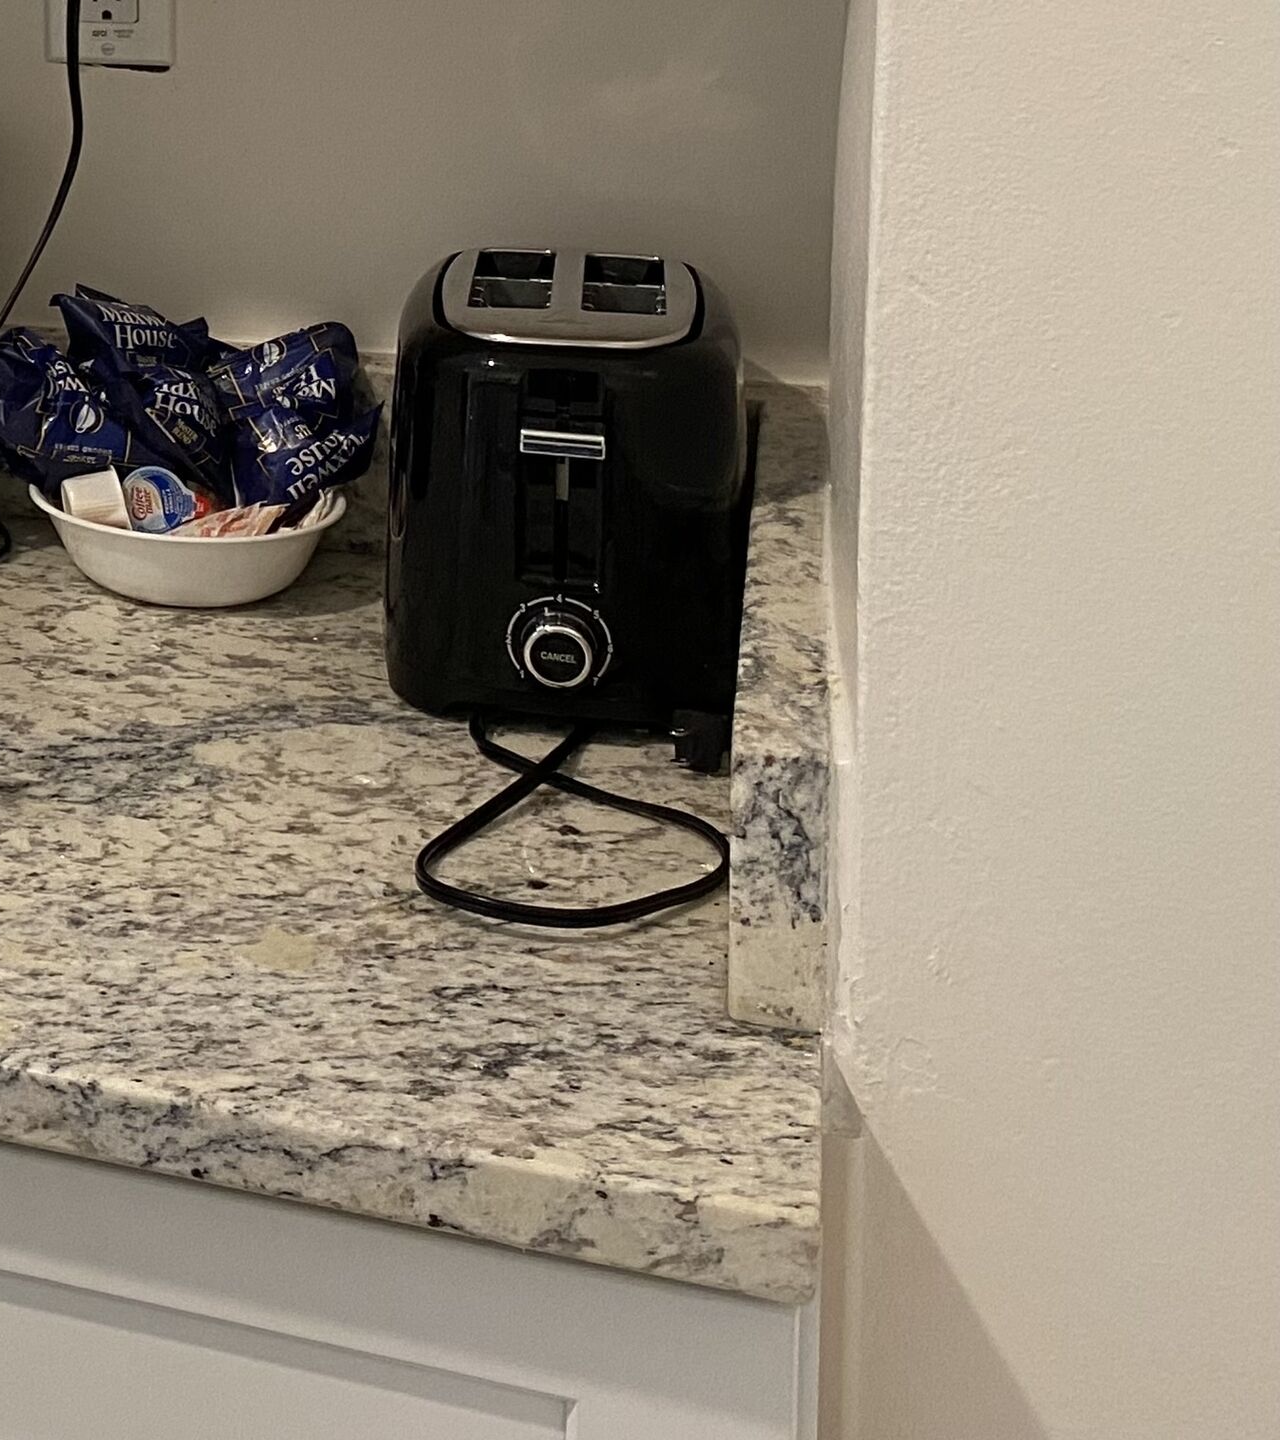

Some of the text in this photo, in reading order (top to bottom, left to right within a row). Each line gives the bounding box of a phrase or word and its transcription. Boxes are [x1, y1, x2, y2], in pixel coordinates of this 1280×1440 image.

[114, 323, 177, 350] House
[556, 593, 563, 603] 4
[519, 603, 526, 613] 3
[593, 610, 600, 619] 5
[505, 634, 512, 645] 2
[540, 651, 577, 664] CANCEL
[593, 677, 599, 687] 7
